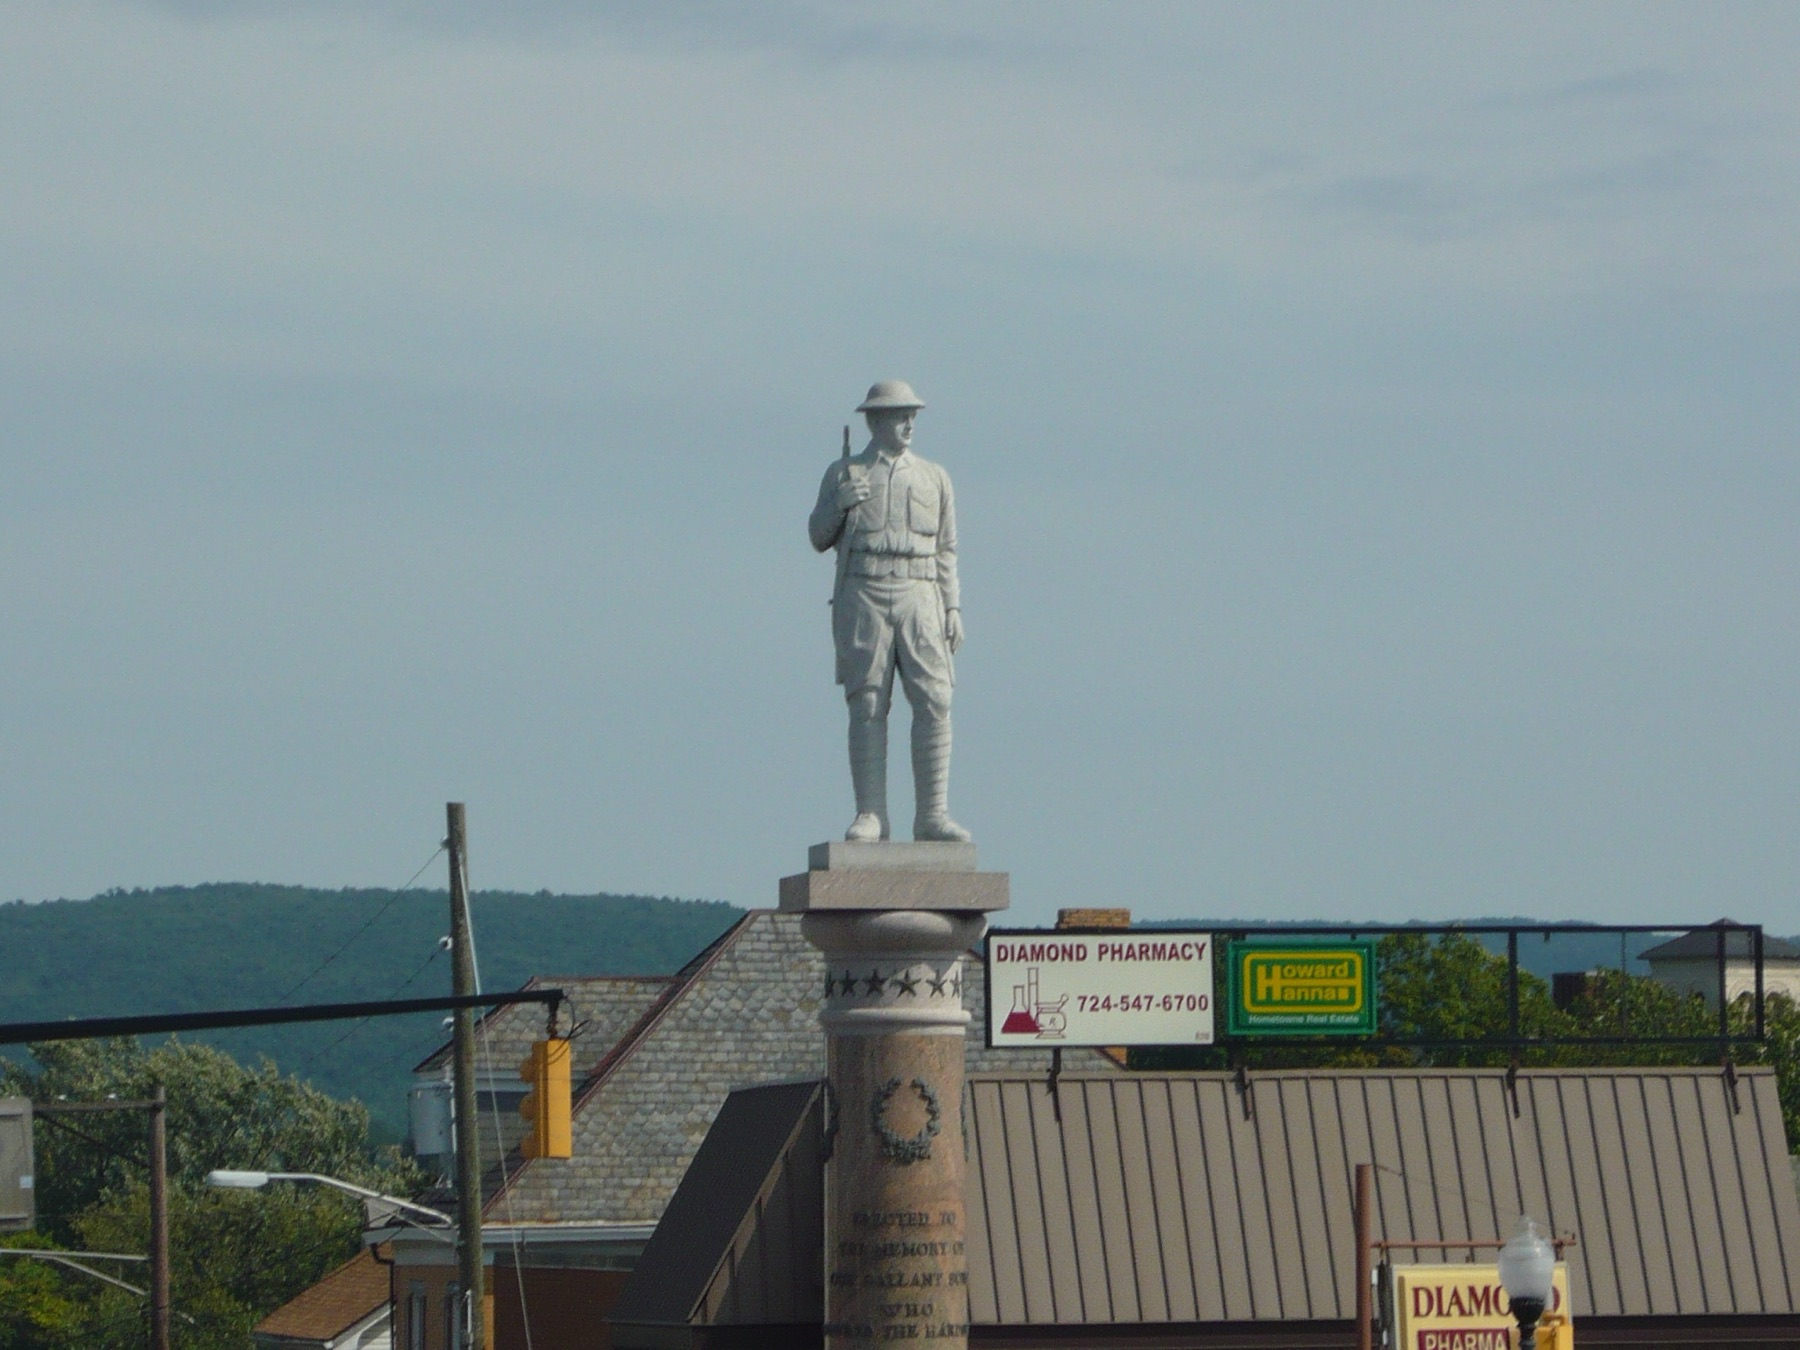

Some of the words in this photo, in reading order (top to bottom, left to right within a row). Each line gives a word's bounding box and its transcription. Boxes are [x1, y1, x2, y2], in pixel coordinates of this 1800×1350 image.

[996, 943, 1088, 962] DIAMOND
[1098, 942, 1207, 961] PHARMACY
[1256, 961, 1349, 985] Howard
[1077, 994, 1209, 1012] 724-547-6700
[1306, 1014, 1327, 1023] Real
[1329, 1014, 1360, 1024] Estate
[940, 1210, 957, 1226] TO
[1412, 1284, 1561, 1318] DIAMO
[878, 1303, 934, 1318] WHO
